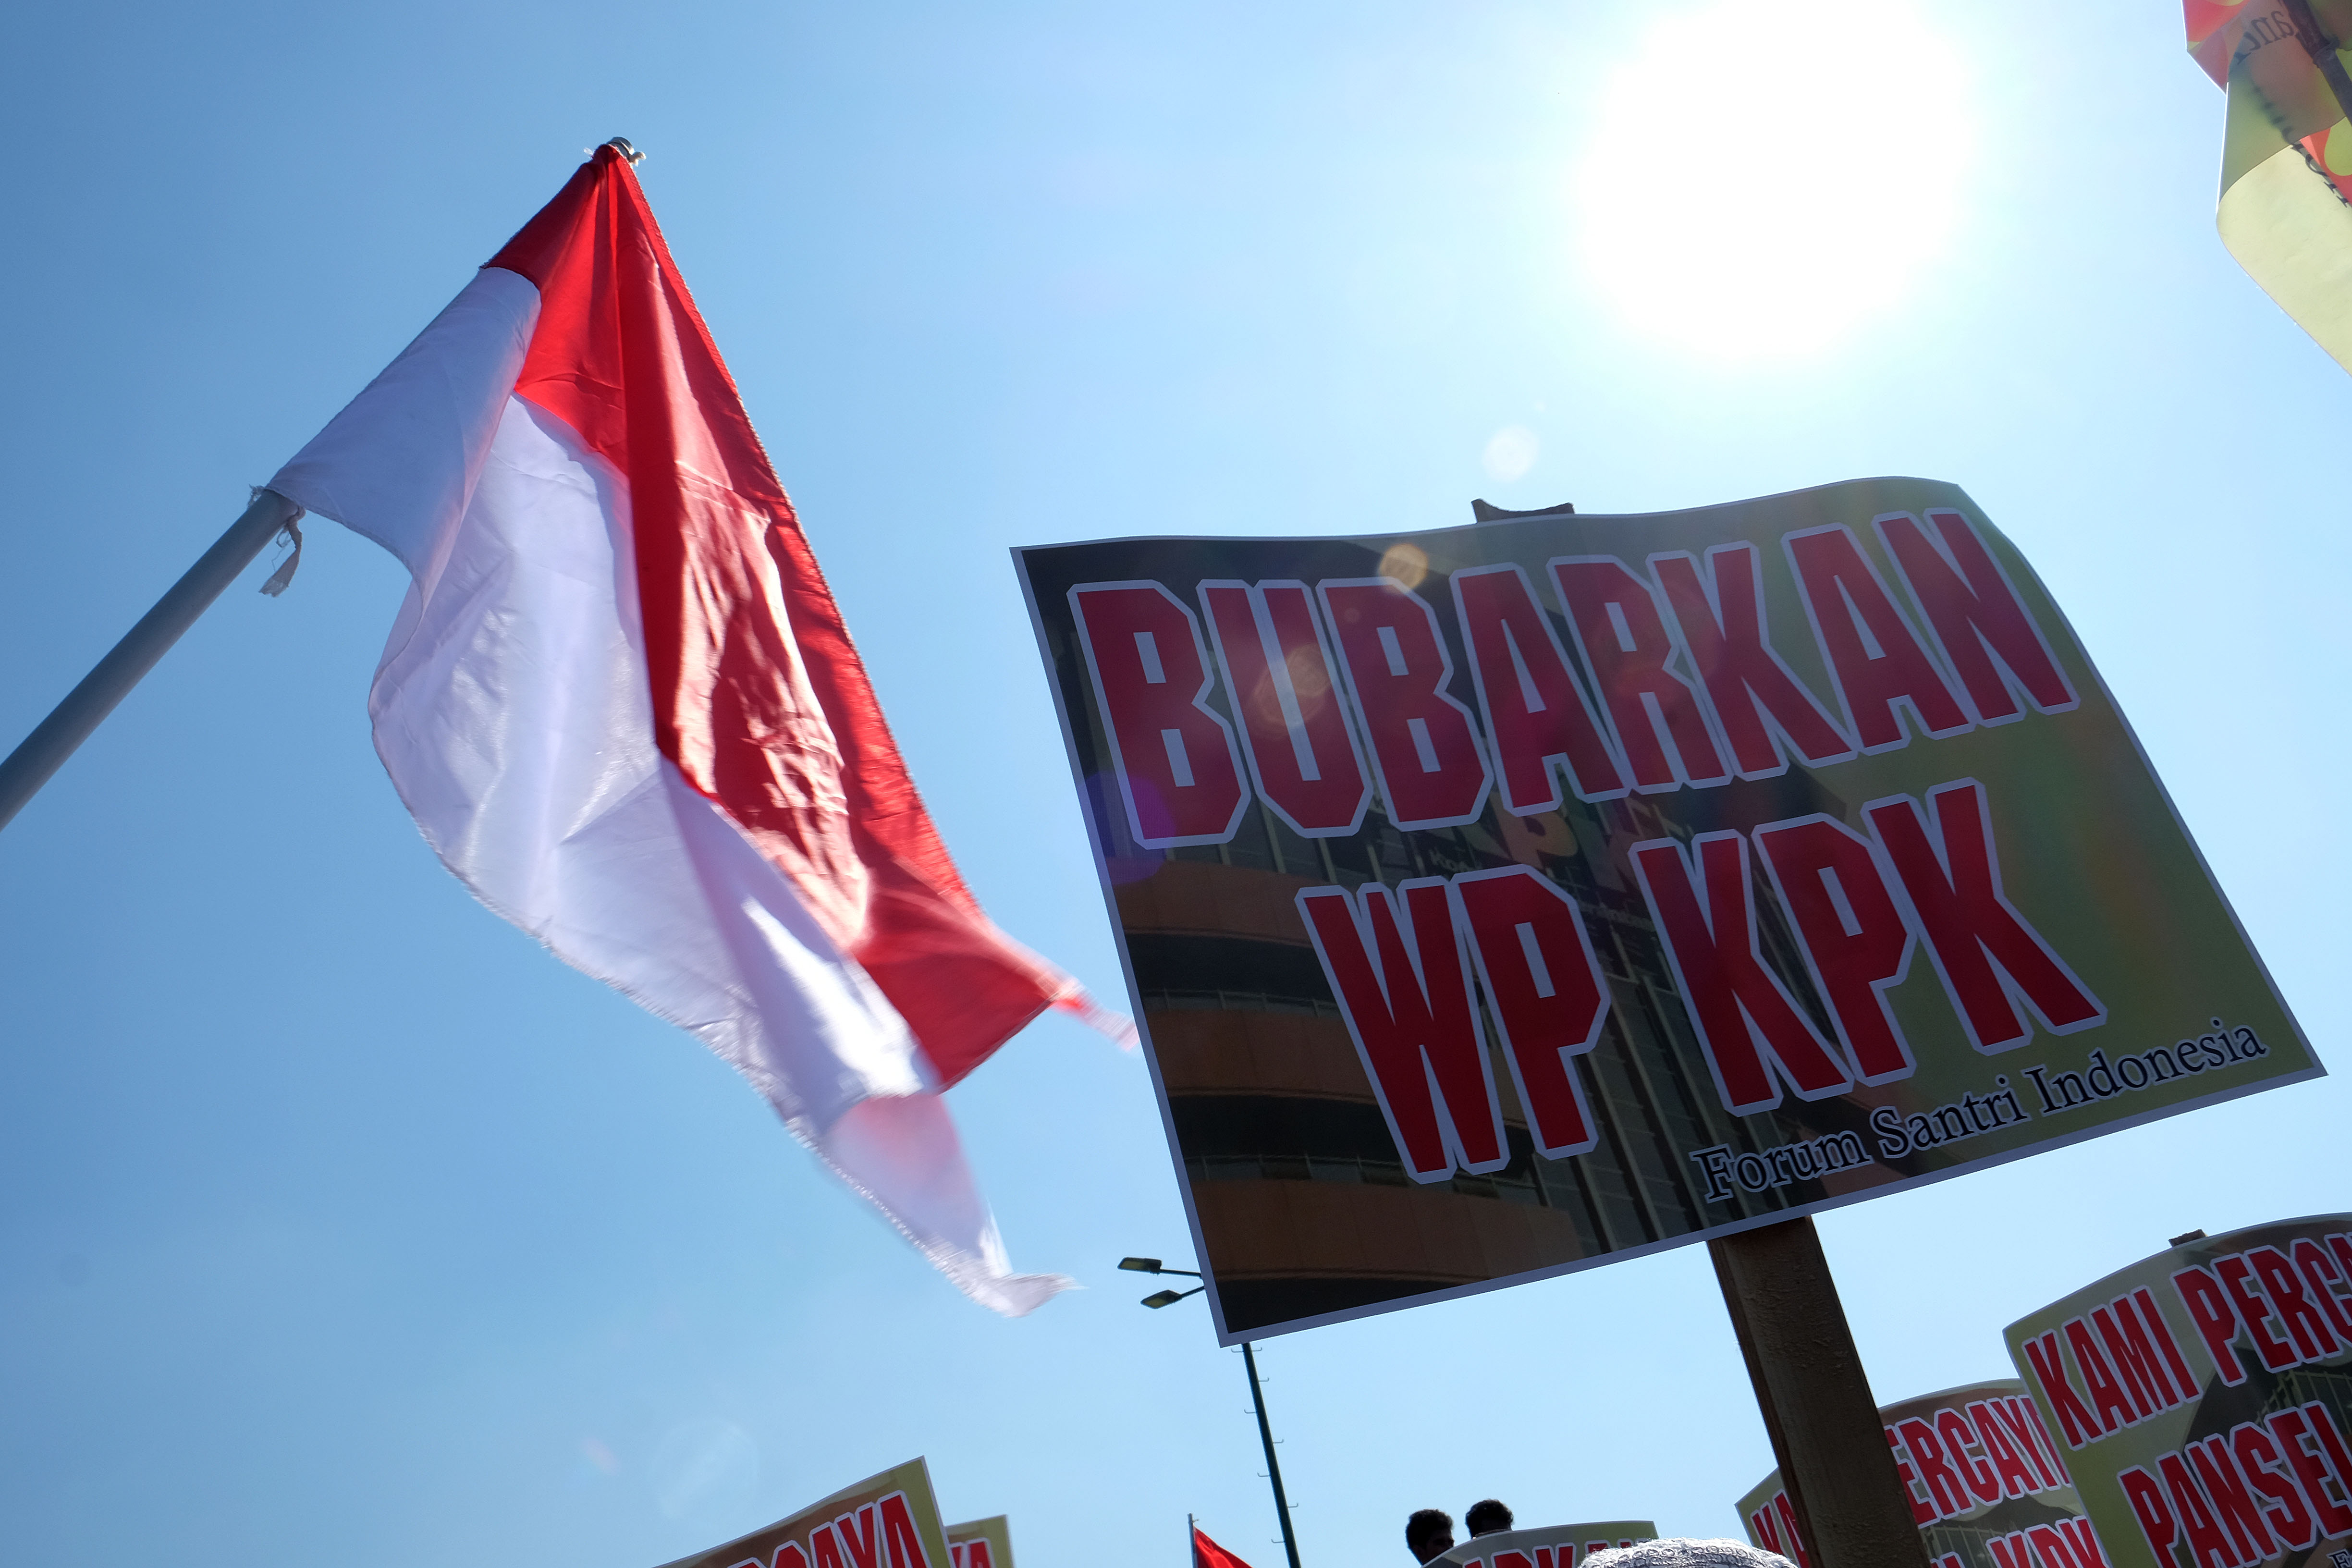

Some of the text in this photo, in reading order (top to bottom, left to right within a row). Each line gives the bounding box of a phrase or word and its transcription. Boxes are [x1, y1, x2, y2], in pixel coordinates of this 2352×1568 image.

[1066, 507, 2080, 849] BUBARKAN
[1294, 777, 2107, 1185] WP KPK
[1689, 1017, 2269, 1203] Forum Santri Indonesia
[2022, 1232, 2352, 1451] KAMI PERC
[1883, 1395, 2072, 1529] ERCAY
